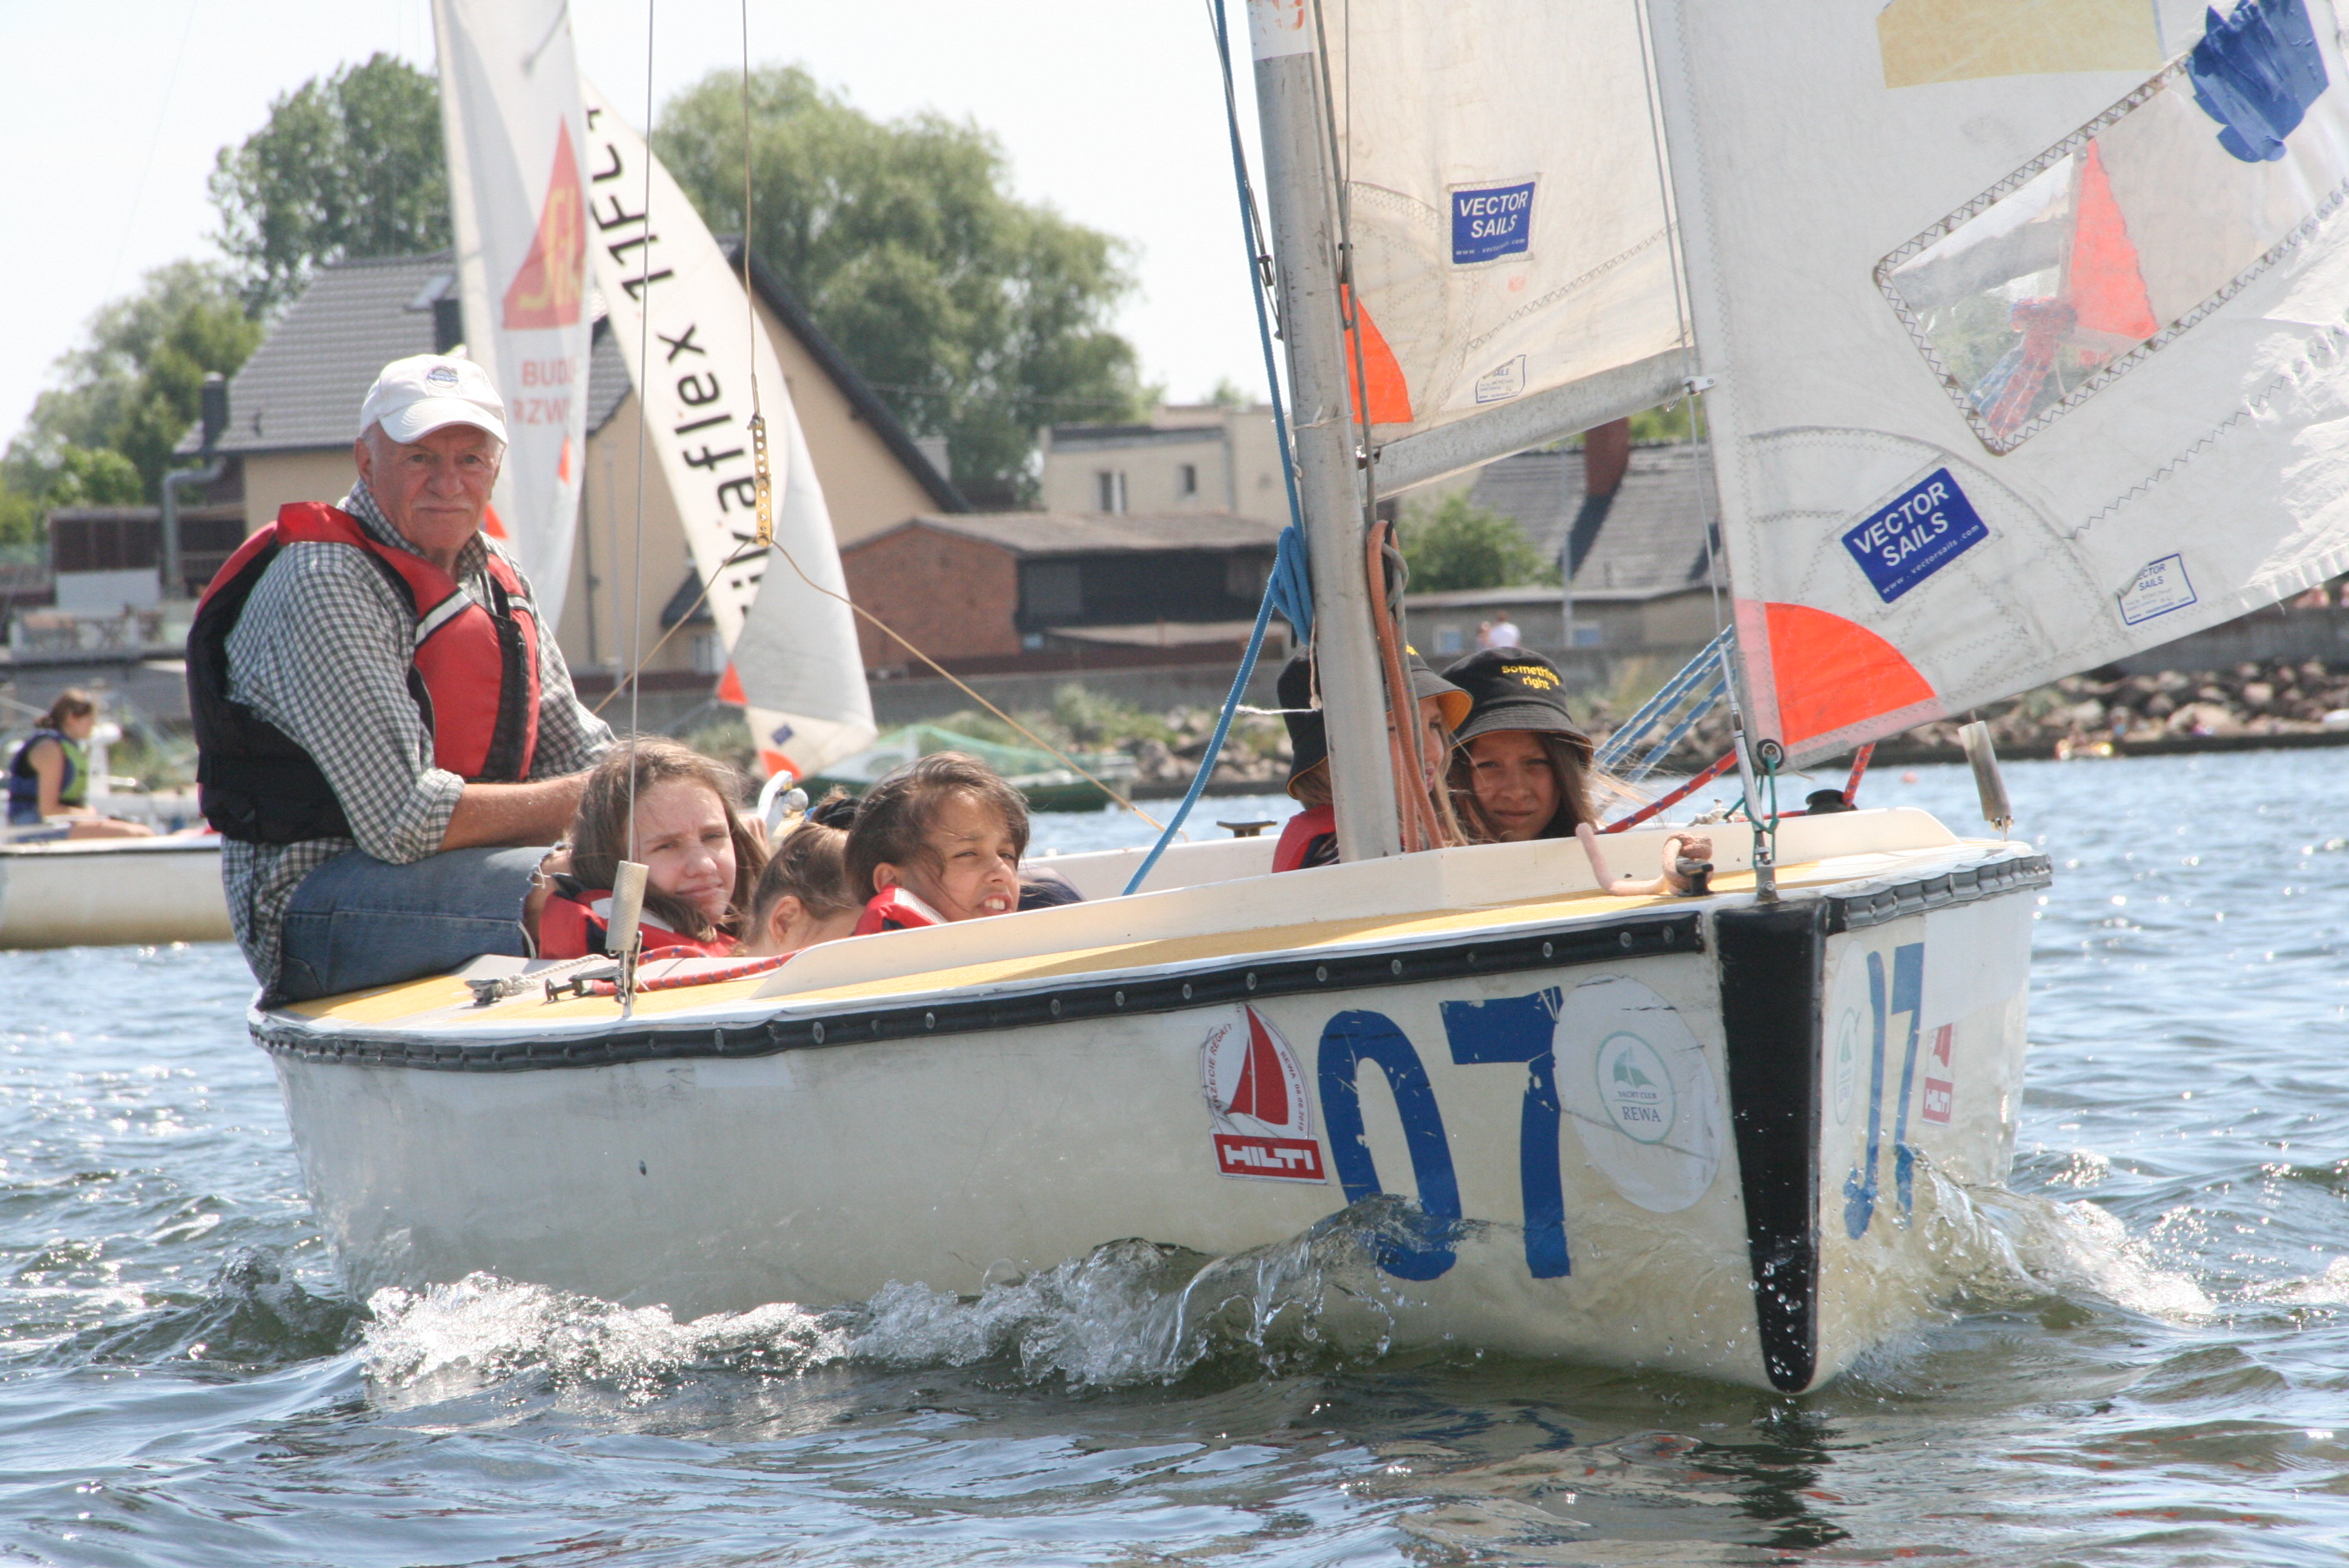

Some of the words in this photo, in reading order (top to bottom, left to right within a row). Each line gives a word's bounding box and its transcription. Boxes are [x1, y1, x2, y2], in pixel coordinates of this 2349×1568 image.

[1460, 190, 1529, 217] VECTOR
[1471, 214, 1517, 239] SAILS
[1853, 481, 1949, 554] VECTOR
[1882, 511, 1949, 567] SAILS
[2139, 575, 2165, 591] SAILS
[1501, 665, 1560, 686] something
[1522, 676, 1551, 691] right
[1280, 1051, 1296, 1079] REWA
[1622, 1106, 1662, 1123] REWA
[1317, 986, 1571, 1281] 07
[1223, 1145, 1315, 1171] HILTI
